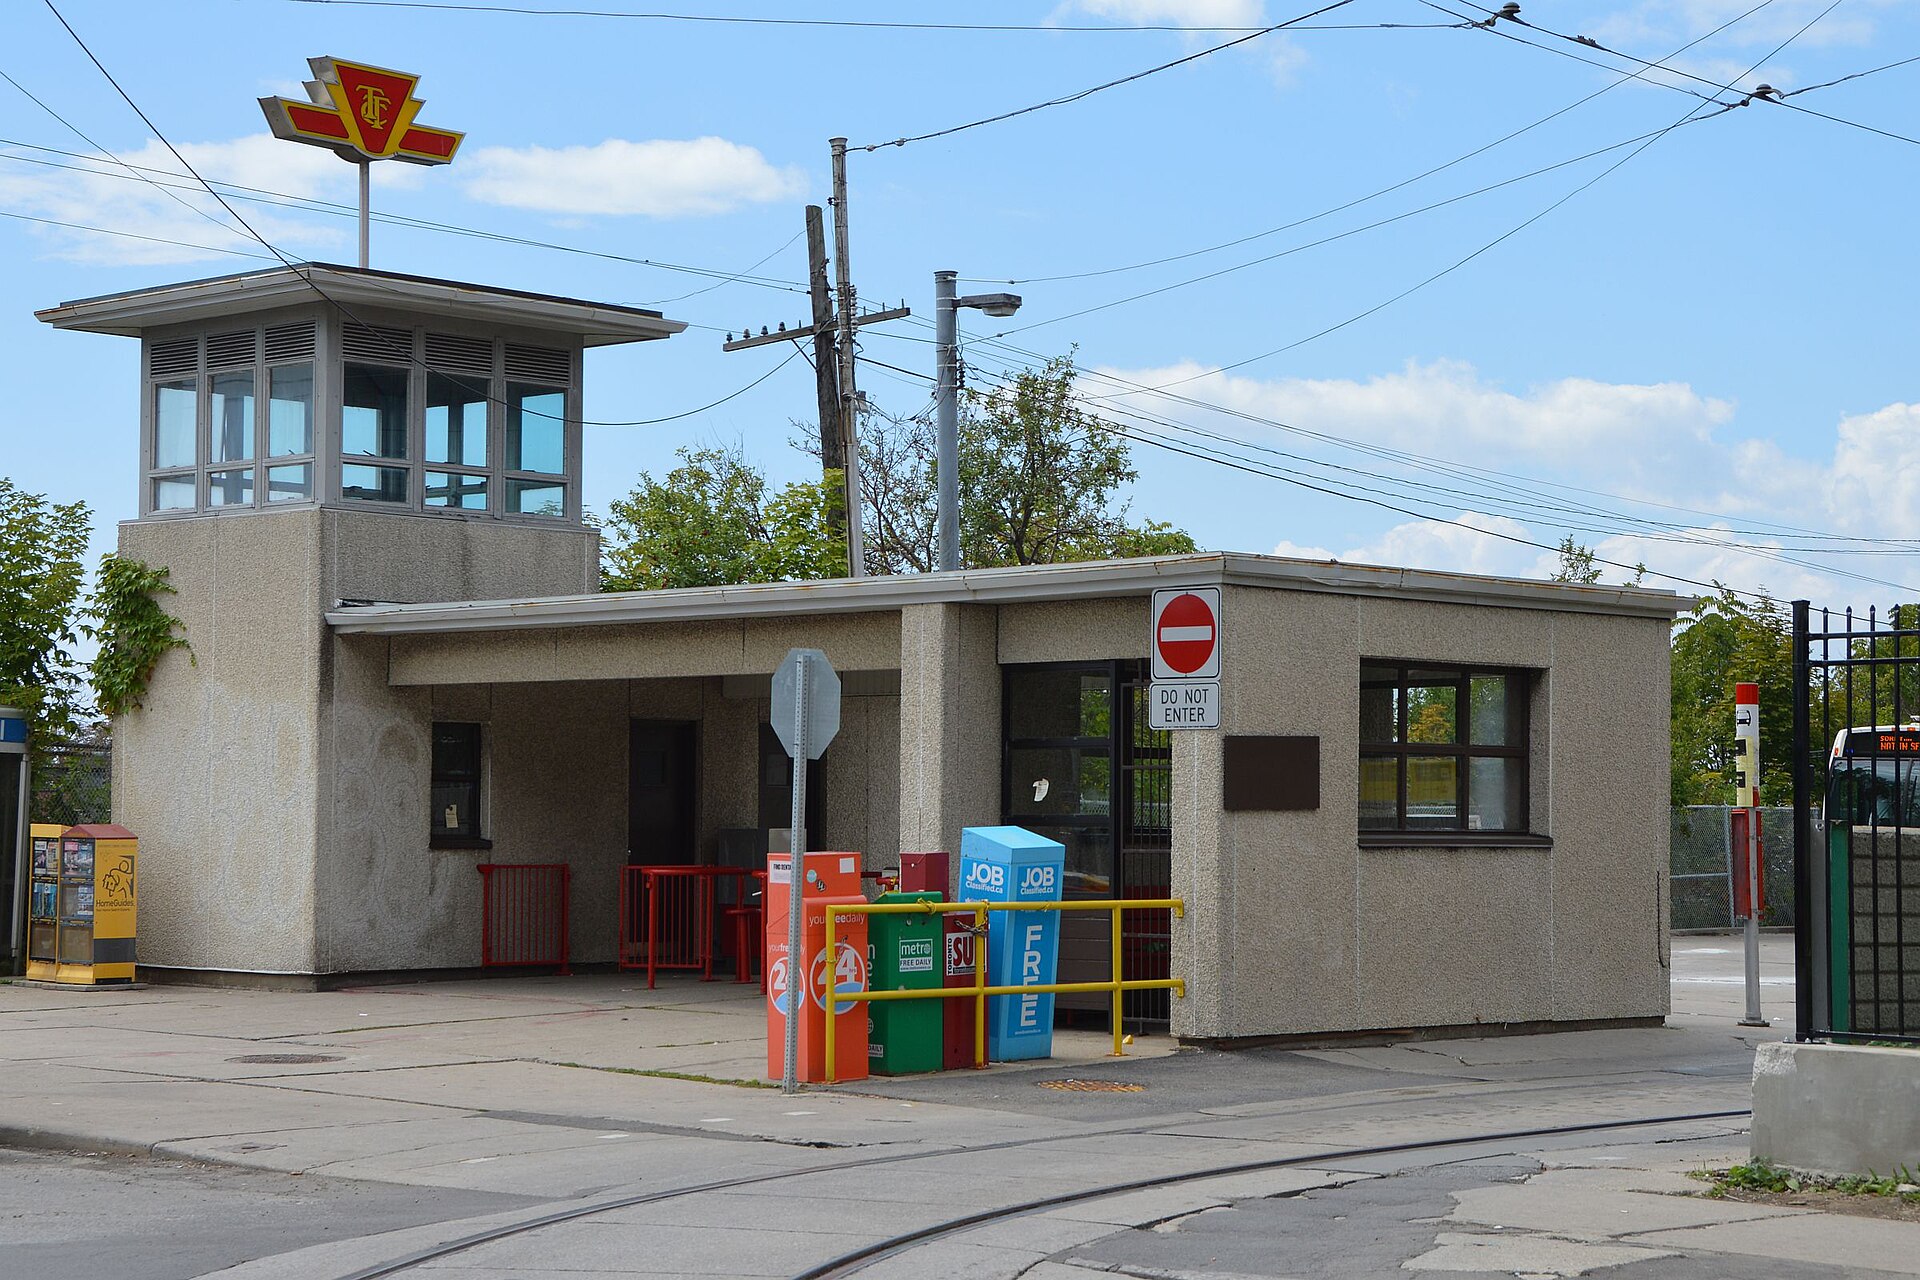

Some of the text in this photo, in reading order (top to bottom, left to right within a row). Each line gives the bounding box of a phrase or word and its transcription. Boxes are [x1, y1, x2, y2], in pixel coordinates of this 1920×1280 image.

[1161, 688, 1209, 704] DO NOT
[1164, 707, 1205, 722] ENTER
[966, 862, 1004, 886] JOB
[1021, 867, 1055, 887] JOB
[965, 881, 1003, 894] Classified.ca
[1020, 886, 1054, 895] Classified.ca
[809, 913, 865, 927] youeedaily
[901, 943, 932, 955] metro
[953, 936, 975, 966] SU
[900, 958, 932, 966] FREE DAILY
[1020, 925, 1042, 1026] FREE
